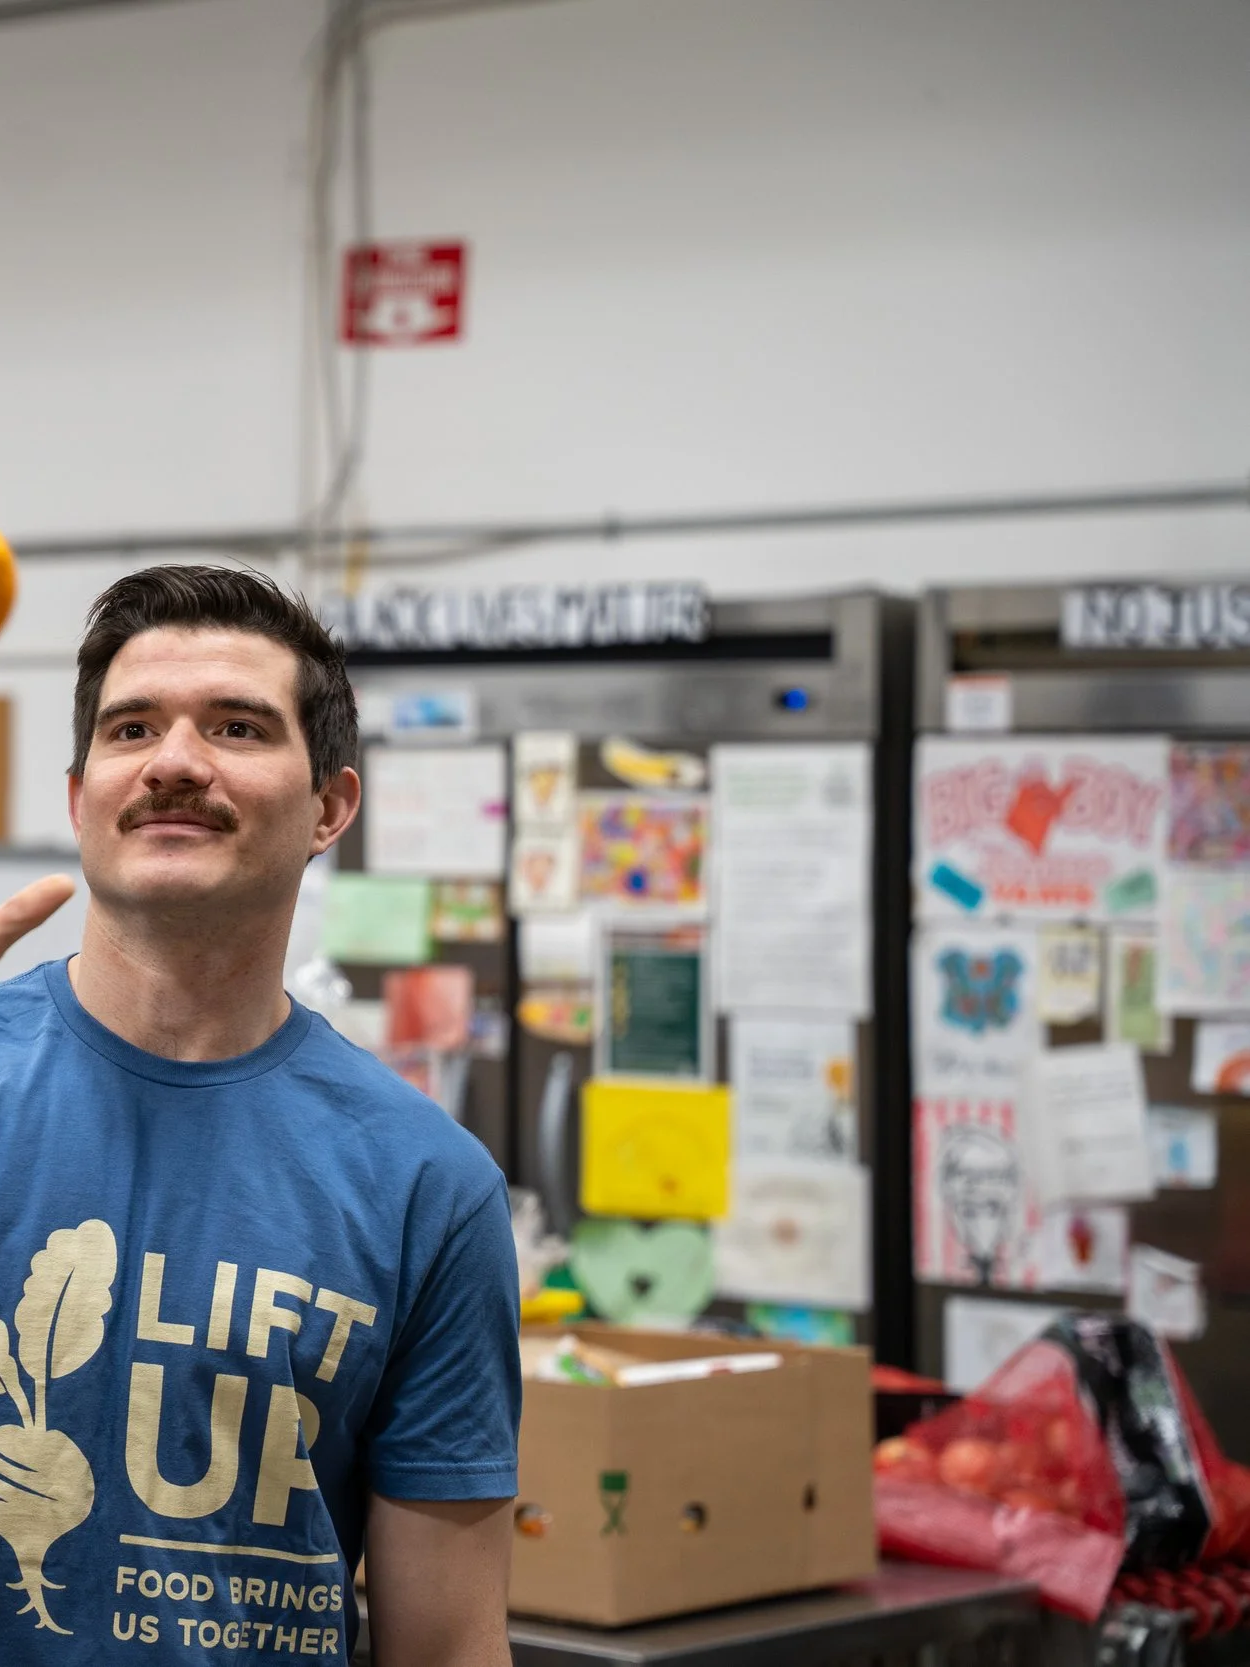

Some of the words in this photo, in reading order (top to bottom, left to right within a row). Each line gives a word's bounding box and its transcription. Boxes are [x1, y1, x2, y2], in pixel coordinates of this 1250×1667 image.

[137, 1253, 377, 1382] LIFT
[125, 1362, 322, 1527] UP
[116, 1566, 215, 1601] FOOD
[229, 1576, 343, 1612] BRINGS
[113, 1612, 159, 1644] US
[178, 1618, 339, 1654] TOGETHER
